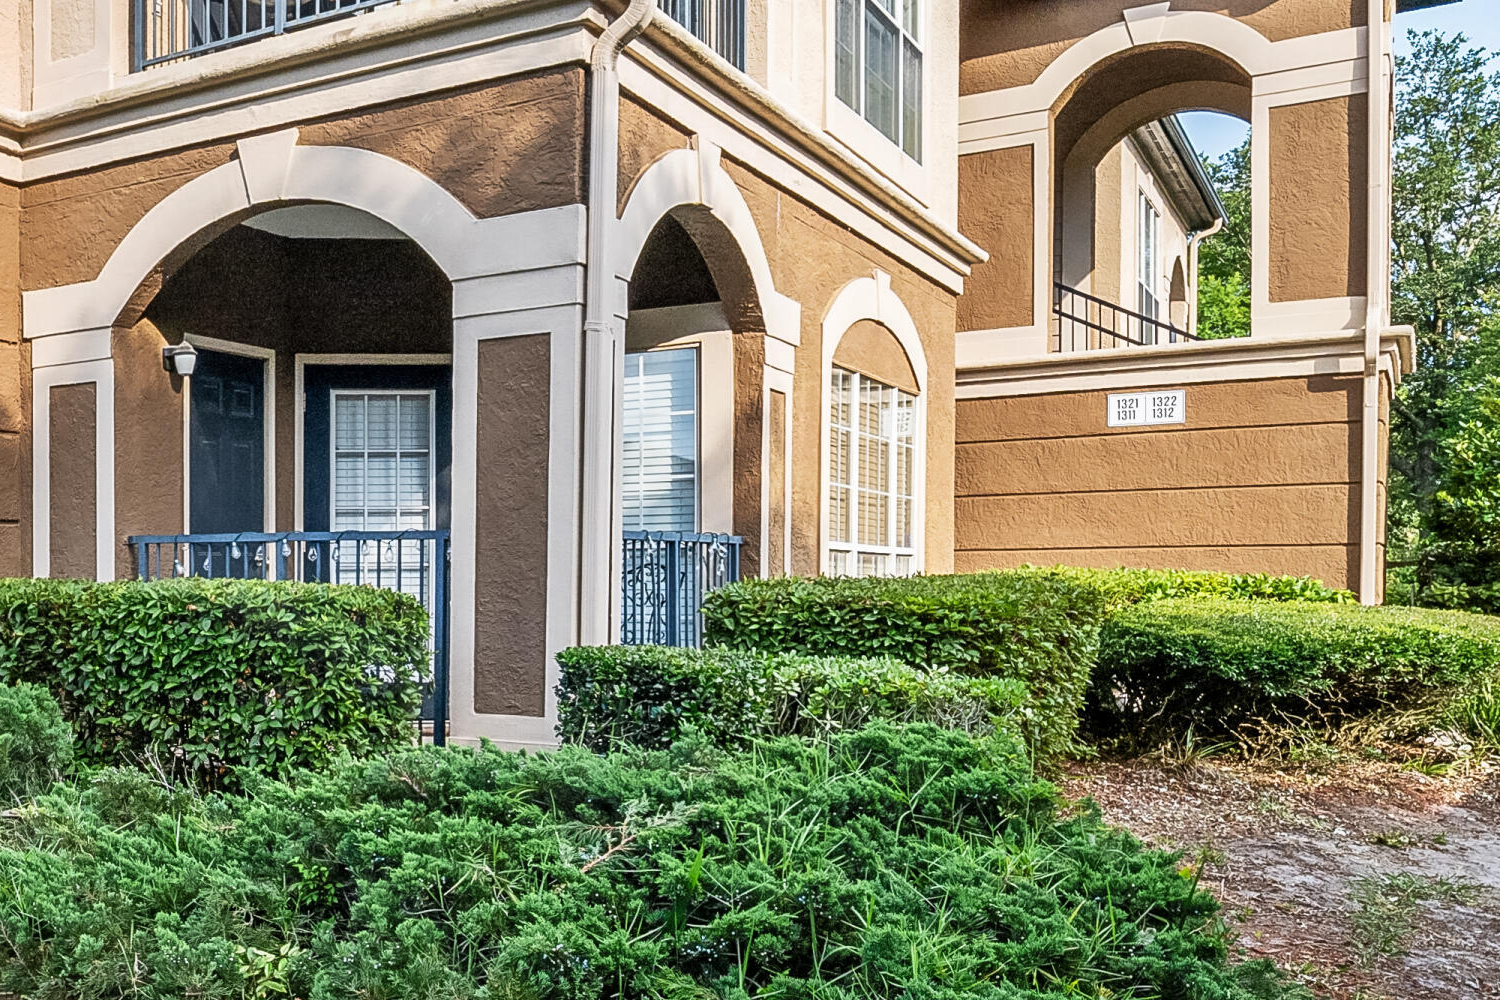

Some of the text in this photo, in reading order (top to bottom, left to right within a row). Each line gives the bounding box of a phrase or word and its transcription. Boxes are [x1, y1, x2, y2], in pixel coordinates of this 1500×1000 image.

[1117, 396, 1177, 409] 1321 1322
[1117, 407, 1174, 420] 1311 1312
